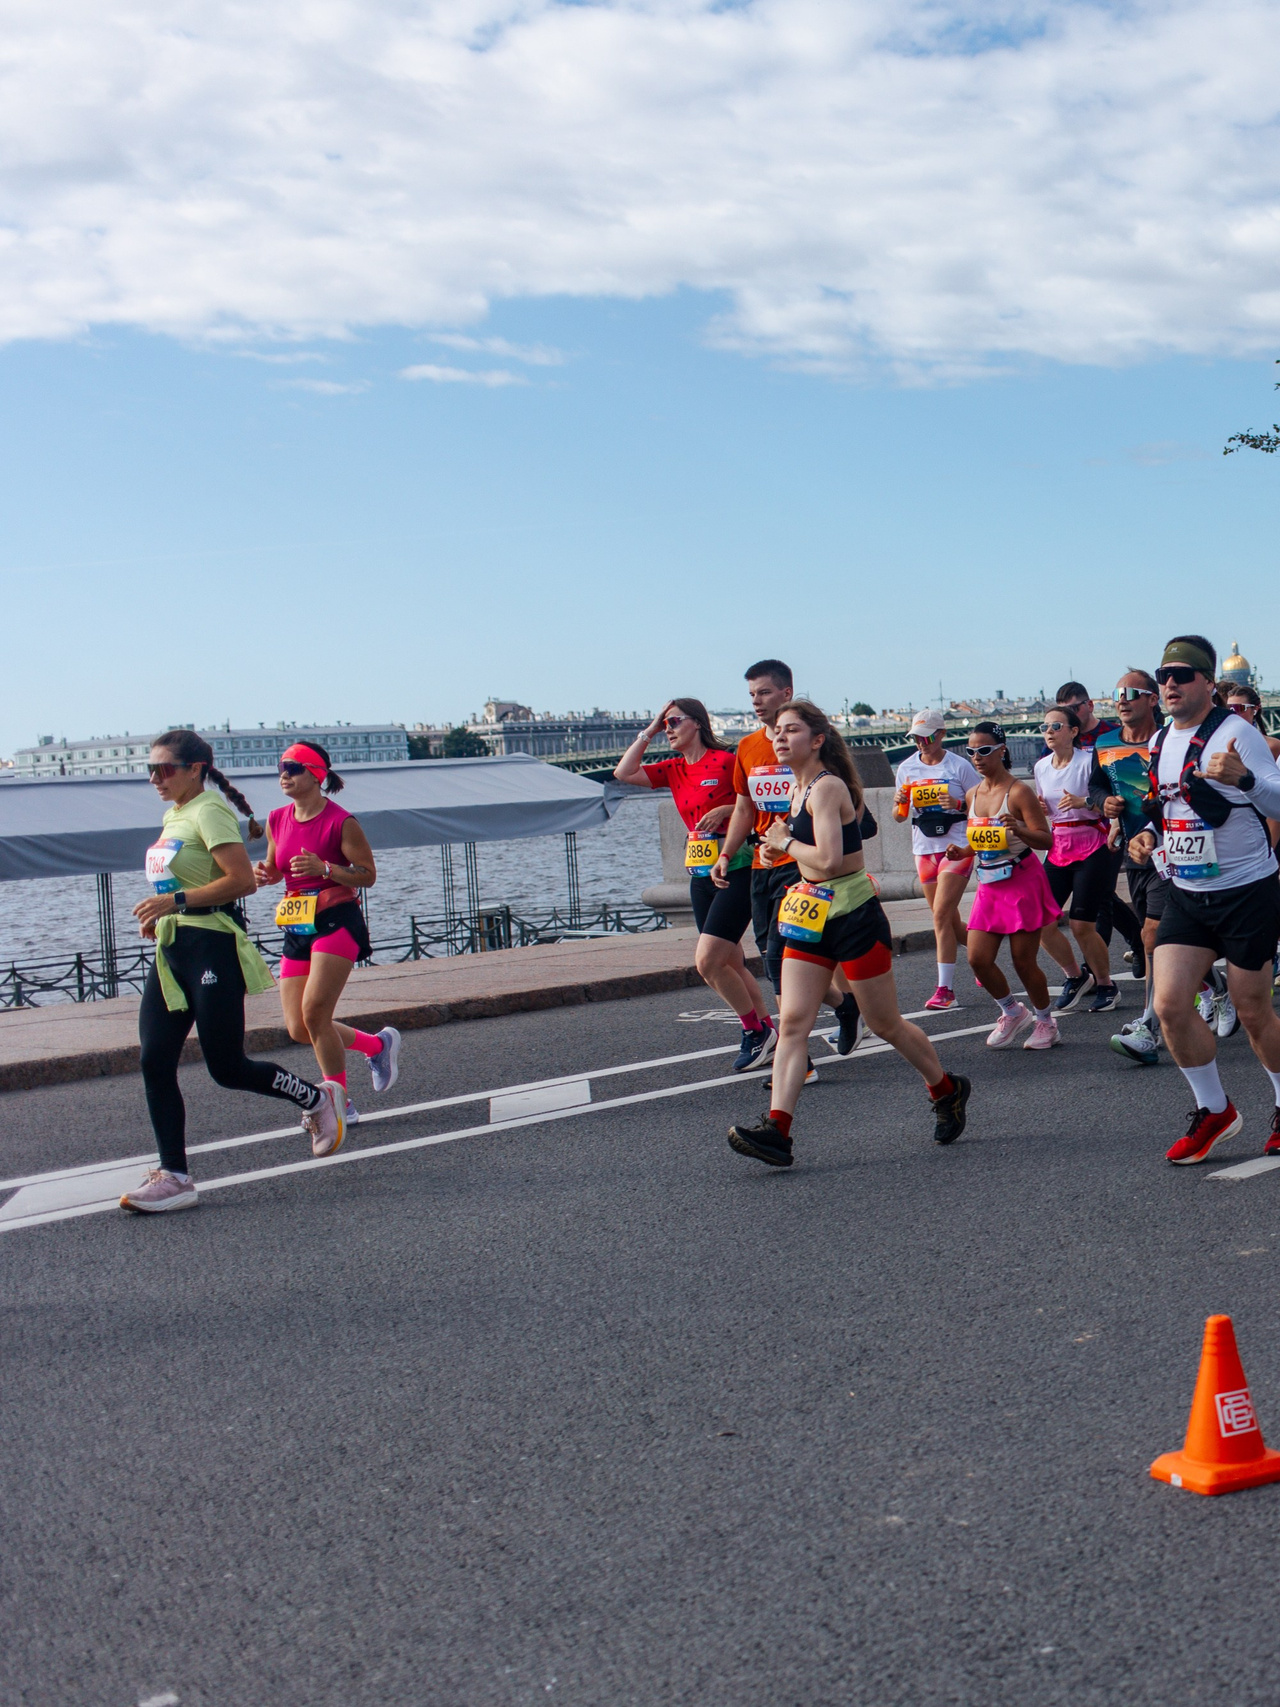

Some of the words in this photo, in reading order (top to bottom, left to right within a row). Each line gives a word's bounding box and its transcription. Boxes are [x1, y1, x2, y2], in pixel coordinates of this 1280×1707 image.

[755, 781, 790, 797] 6969
[972, 830, 1000, 843] 4685
[1168, 836, 1205, 855] 2427
[279, 899, 308, 917] 5891
[783, 896, 819, 920] 6496
[272, 1071, 316, 1108] Kappa
